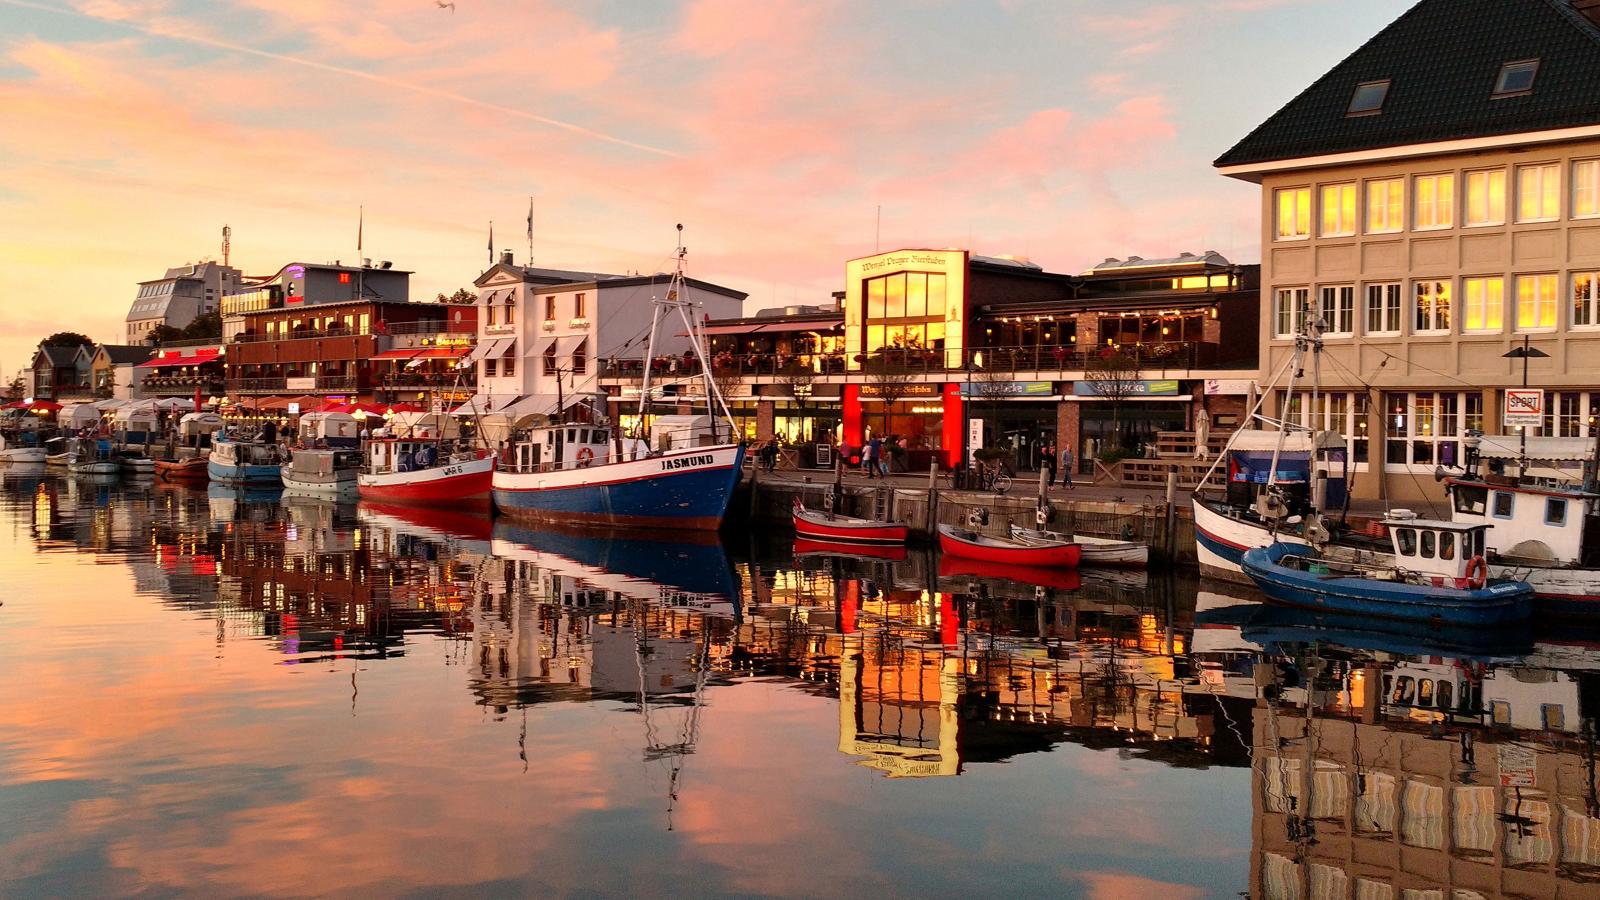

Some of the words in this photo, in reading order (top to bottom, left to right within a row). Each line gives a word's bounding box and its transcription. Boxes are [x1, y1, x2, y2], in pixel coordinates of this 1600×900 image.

[1510, 397, 1538, 408] SPORT
[661, 455, 714, 470] JASMUND
[442, 466, 456, 475] WAR
